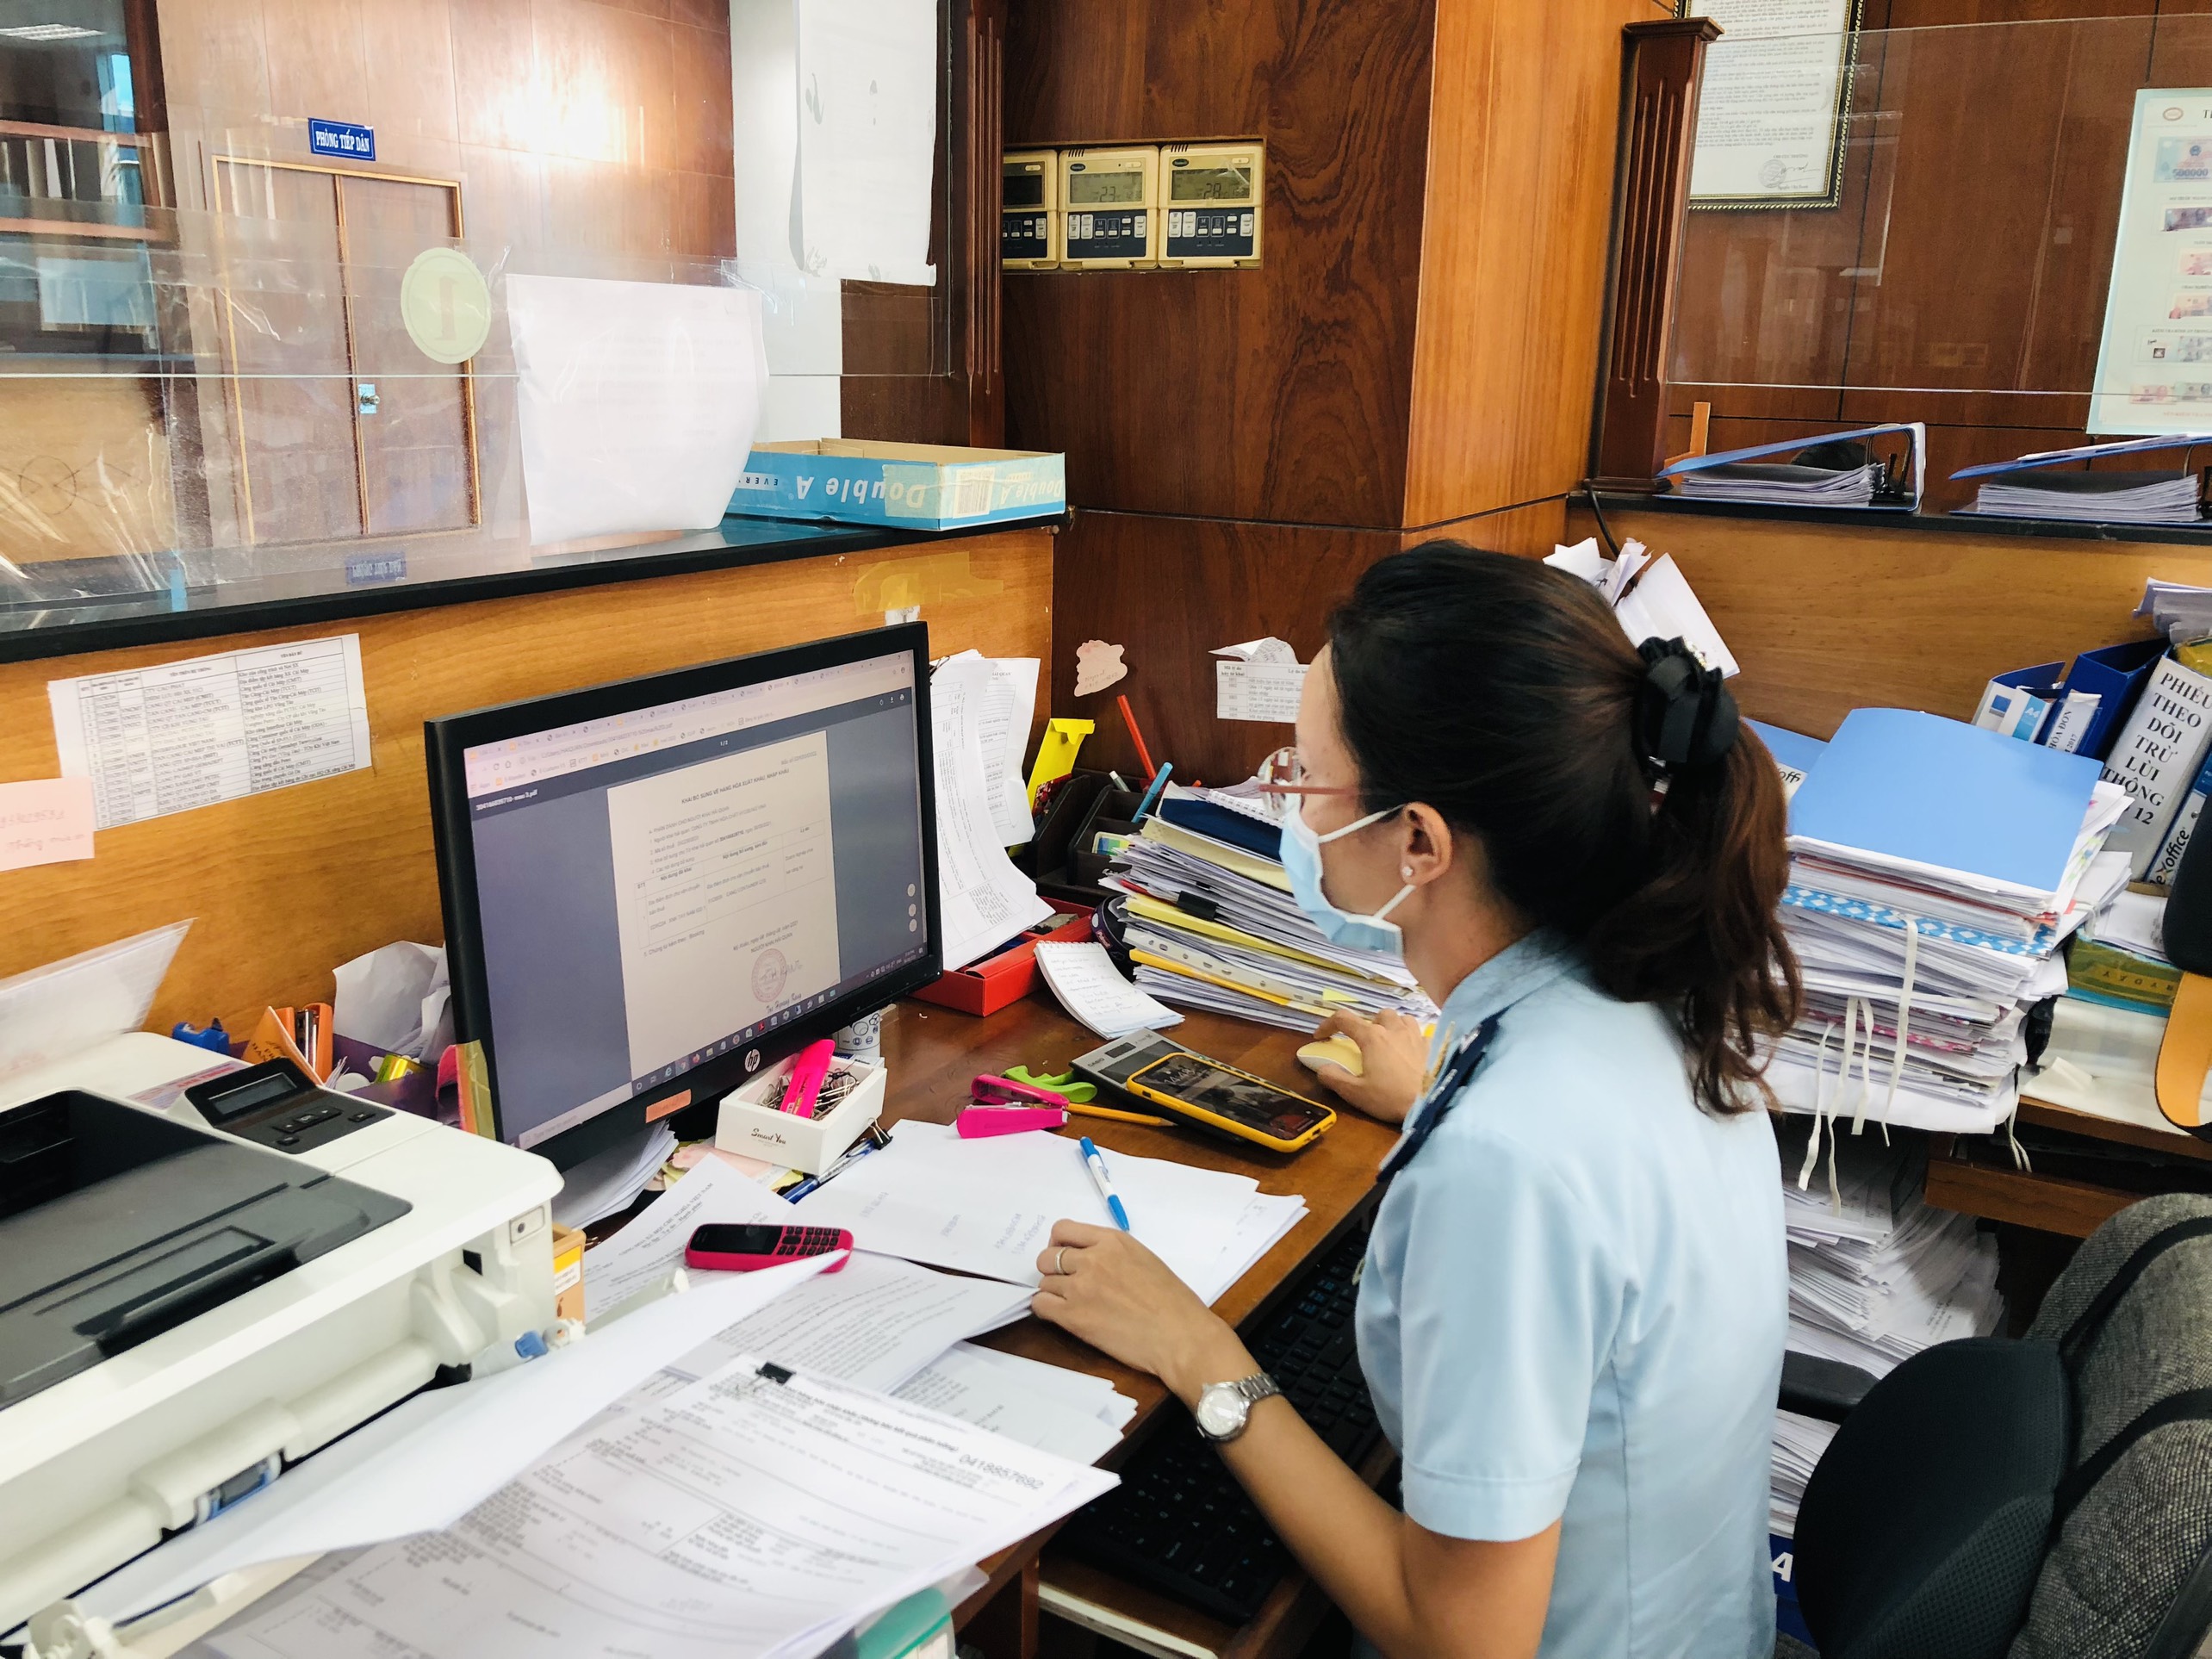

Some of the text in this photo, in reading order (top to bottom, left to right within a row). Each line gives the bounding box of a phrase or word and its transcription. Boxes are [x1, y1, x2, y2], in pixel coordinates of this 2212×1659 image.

[315, 127, 370, 152] PHÒNG TIẾP DÂN
[1100, 186, 1115, 202] 23
[738, 476, 778, 487] EVER
[796, 475, 925, 508] Double A
[1014, 478, 1064, 503] Double
[2153, 693, 2203, 729] THEO
[2147, 716, 2183, 744] DÕI
[2135, 734, 2178, 764] TRỪ
[2125, 755, 2160, 781] LÙI
[2102, 767, 2165, 806] THÔNG
[2134, 806, 2153, 825] 12
[747, 1051, 759, 1070] hp
[751, 1128, 786, 1144] Smart You
